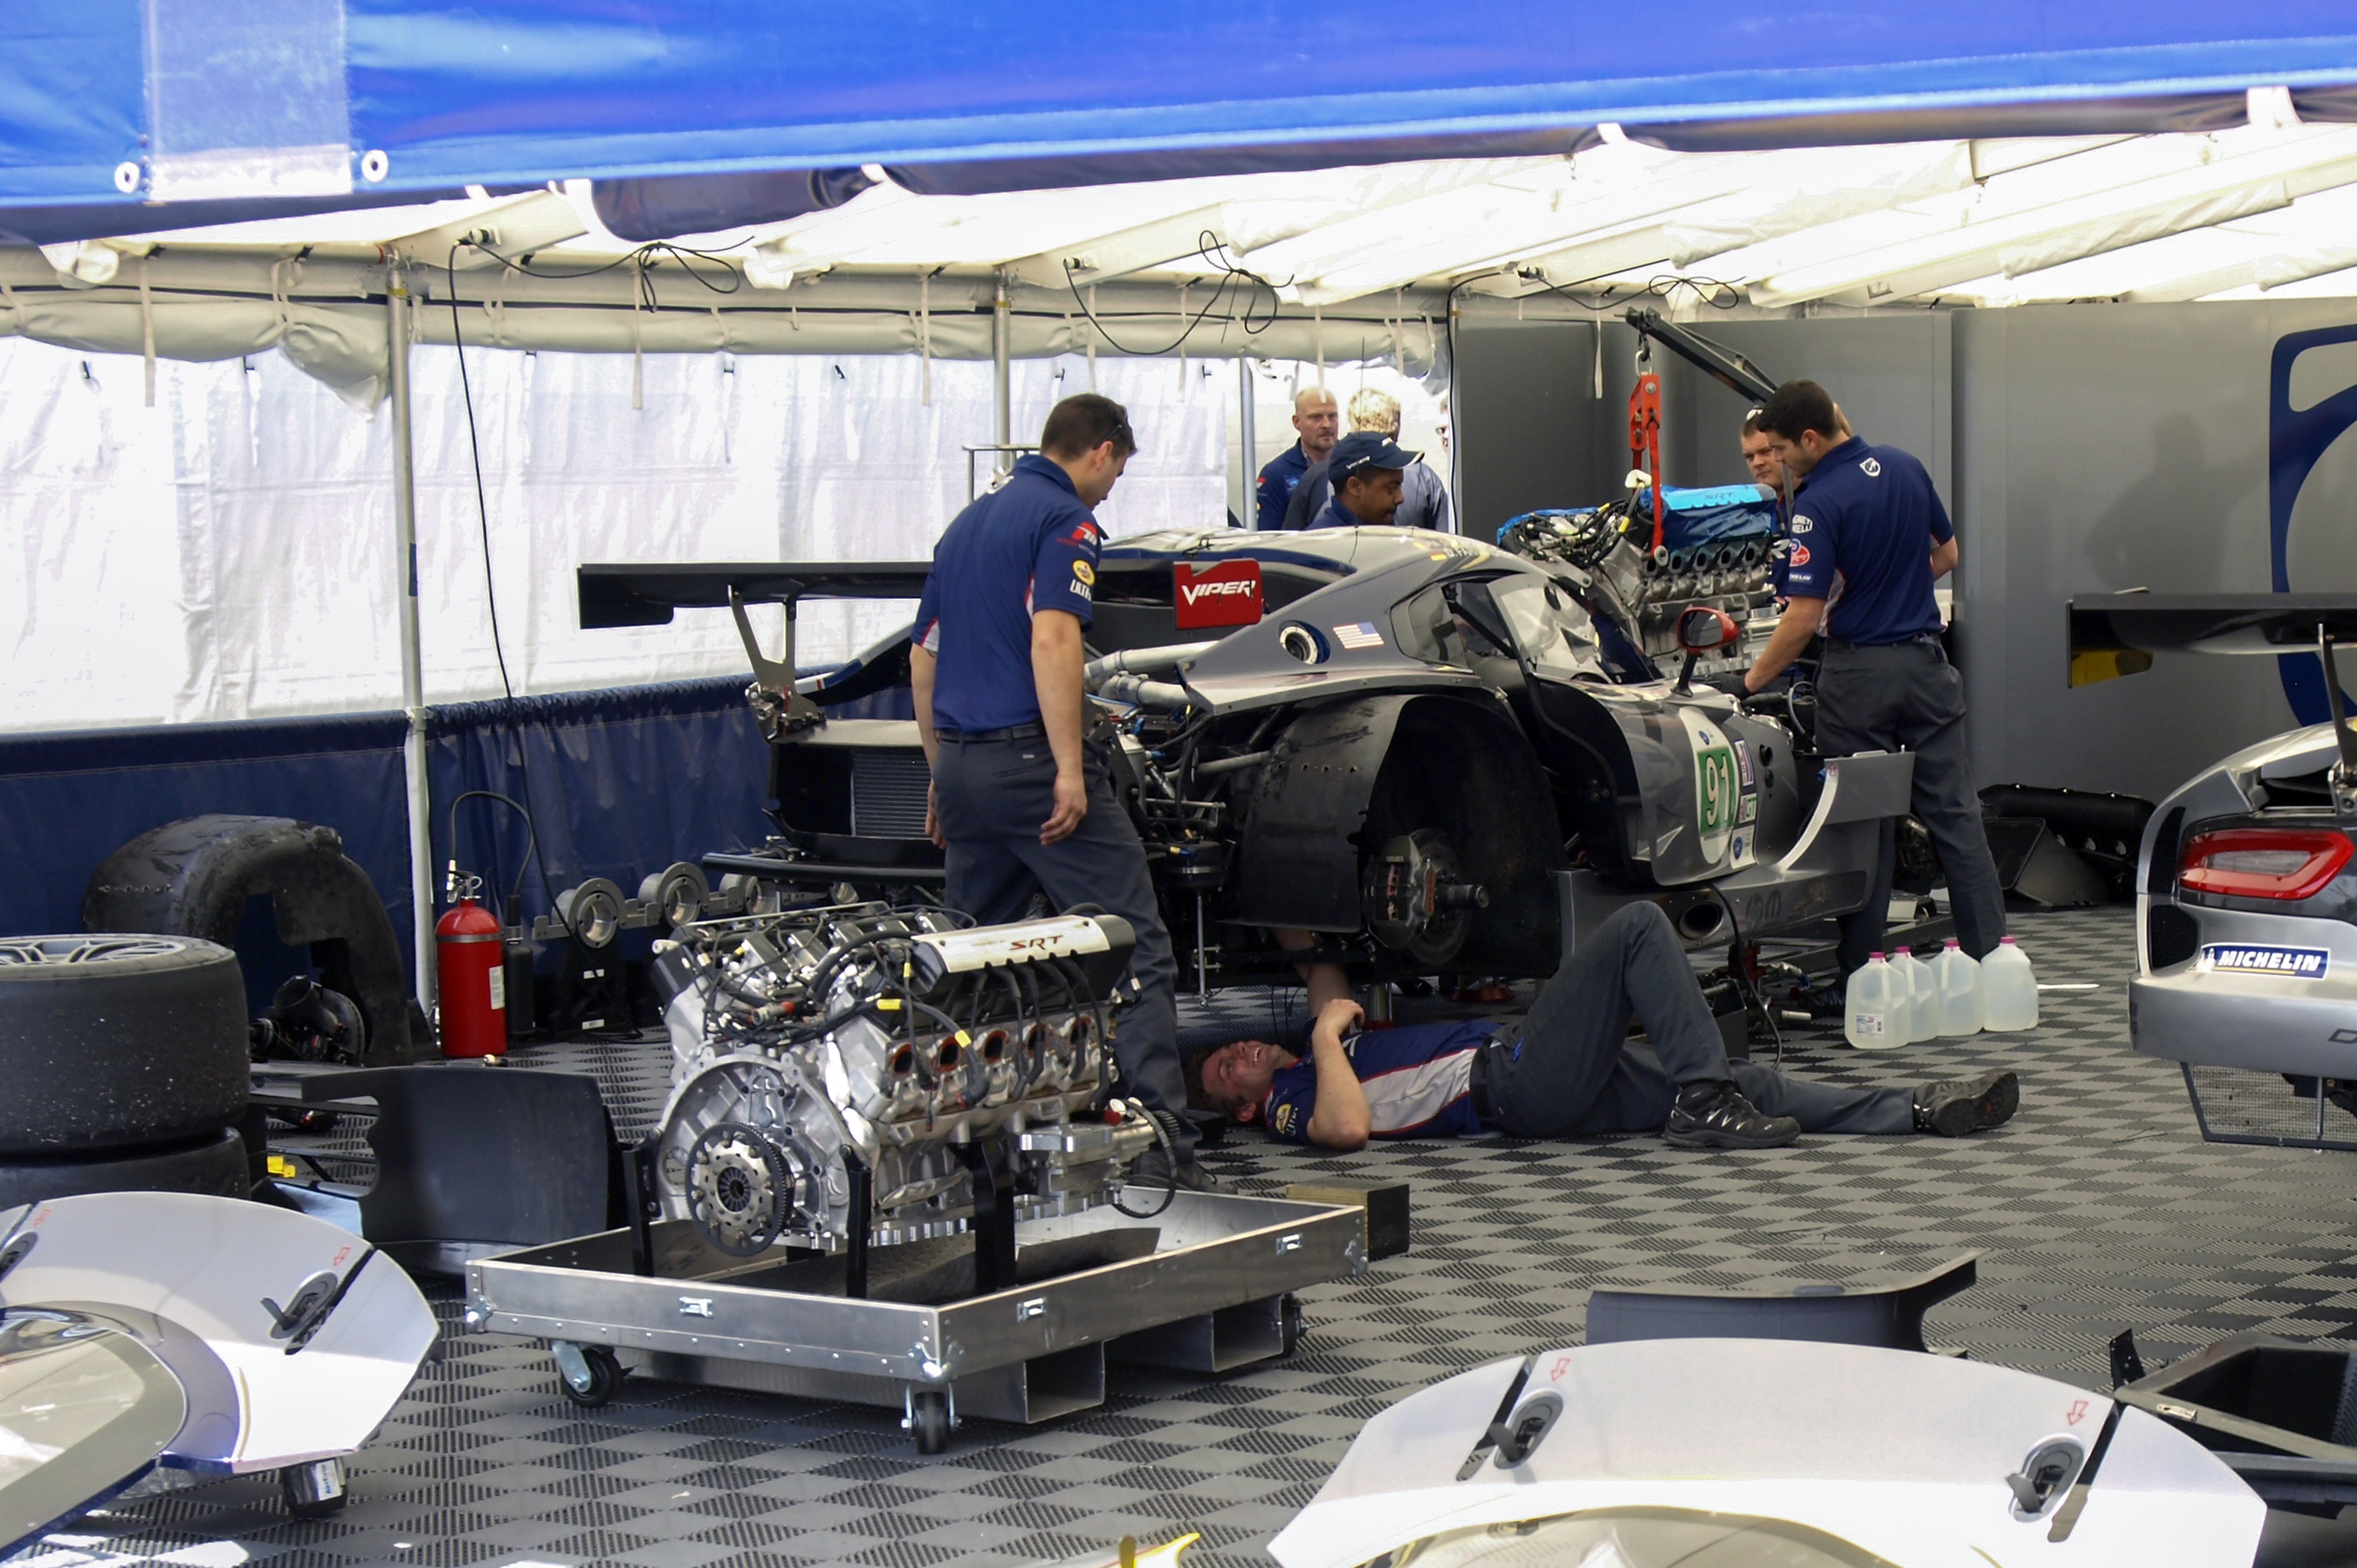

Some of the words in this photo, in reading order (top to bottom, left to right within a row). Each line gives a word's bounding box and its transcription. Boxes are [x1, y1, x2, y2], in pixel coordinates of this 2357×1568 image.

[1181, 580, 1256, 606] VIPER
[1706, 753, 1730, 827] 91
[1009, 933, 1063, 951] SRT
[2217, 950, 2322, 972] MICHELIN
